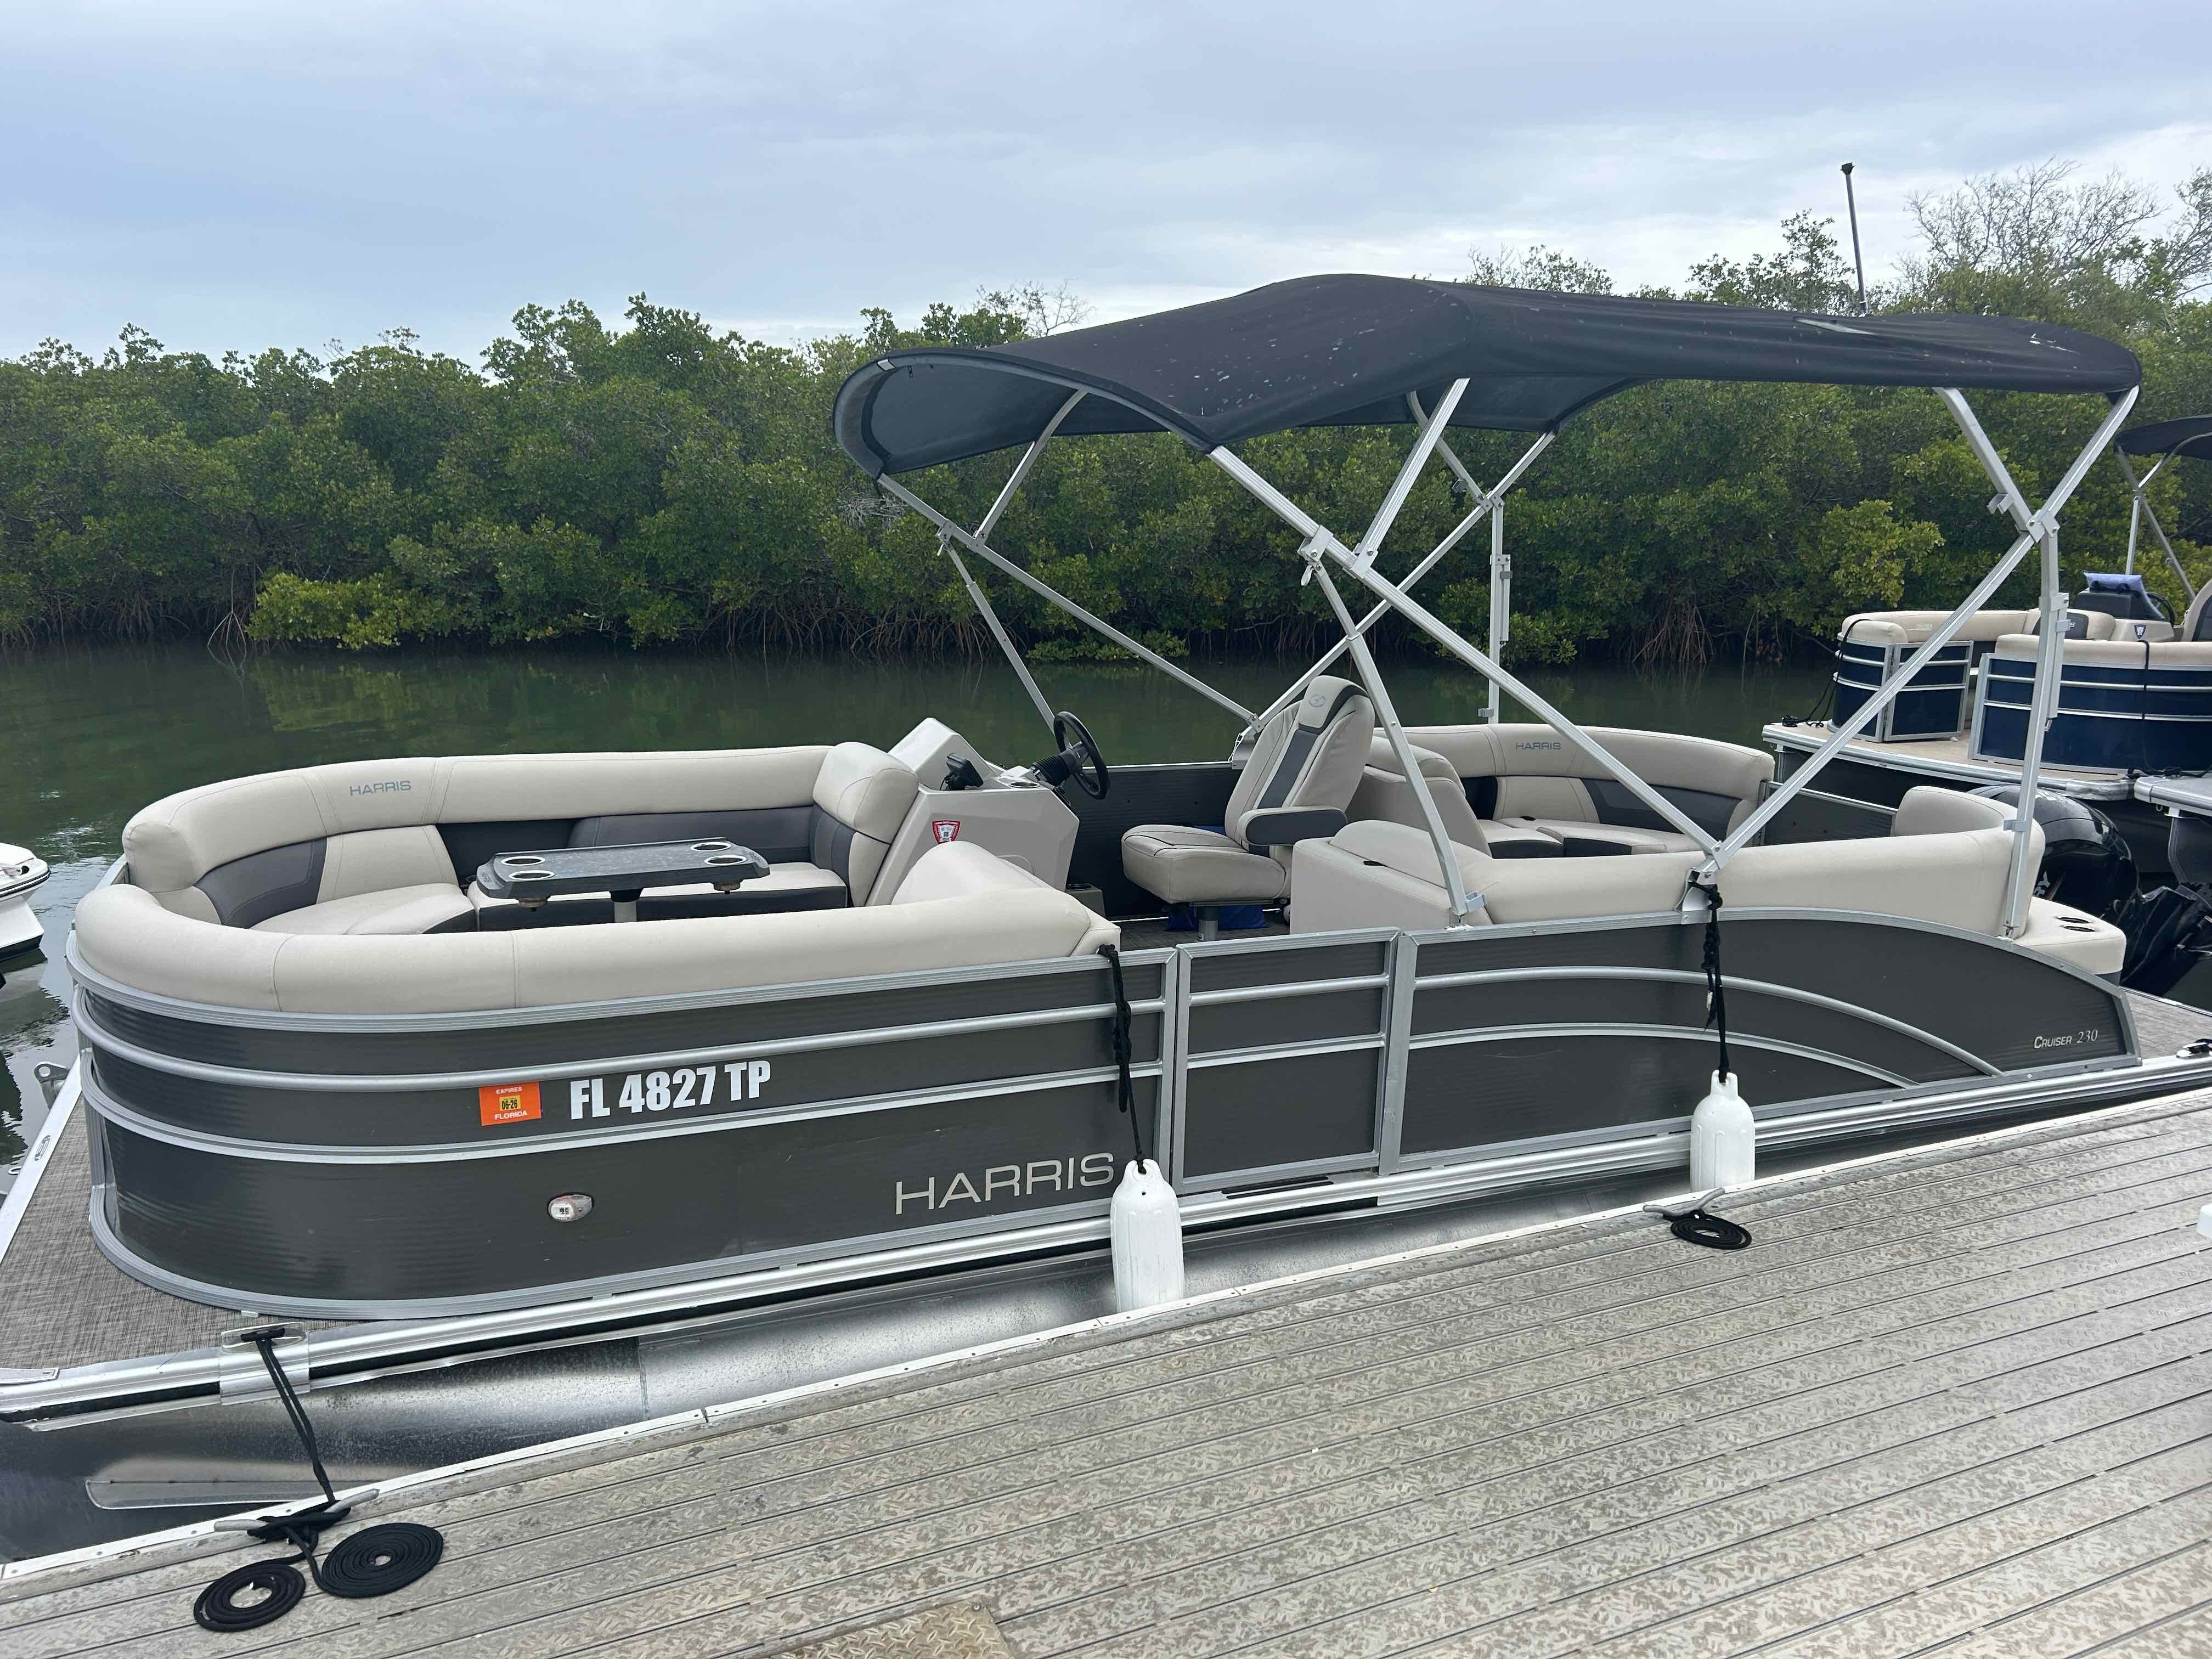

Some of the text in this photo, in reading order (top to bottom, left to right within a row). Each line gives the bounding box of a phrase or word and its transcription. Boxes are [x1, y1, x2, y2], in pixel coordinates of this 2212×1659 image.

[349, 781, 411, 795] HARRIS
[2076, 1029, 2098, 1043] 230
[571, 1060, 770, 1120] FL 4827 TP
[501, 1099, 517, 1110] 06-26
[495, 1110, 527, 1120] FLORIDA
[895, 1153, 1114, 1215] HARRIS
